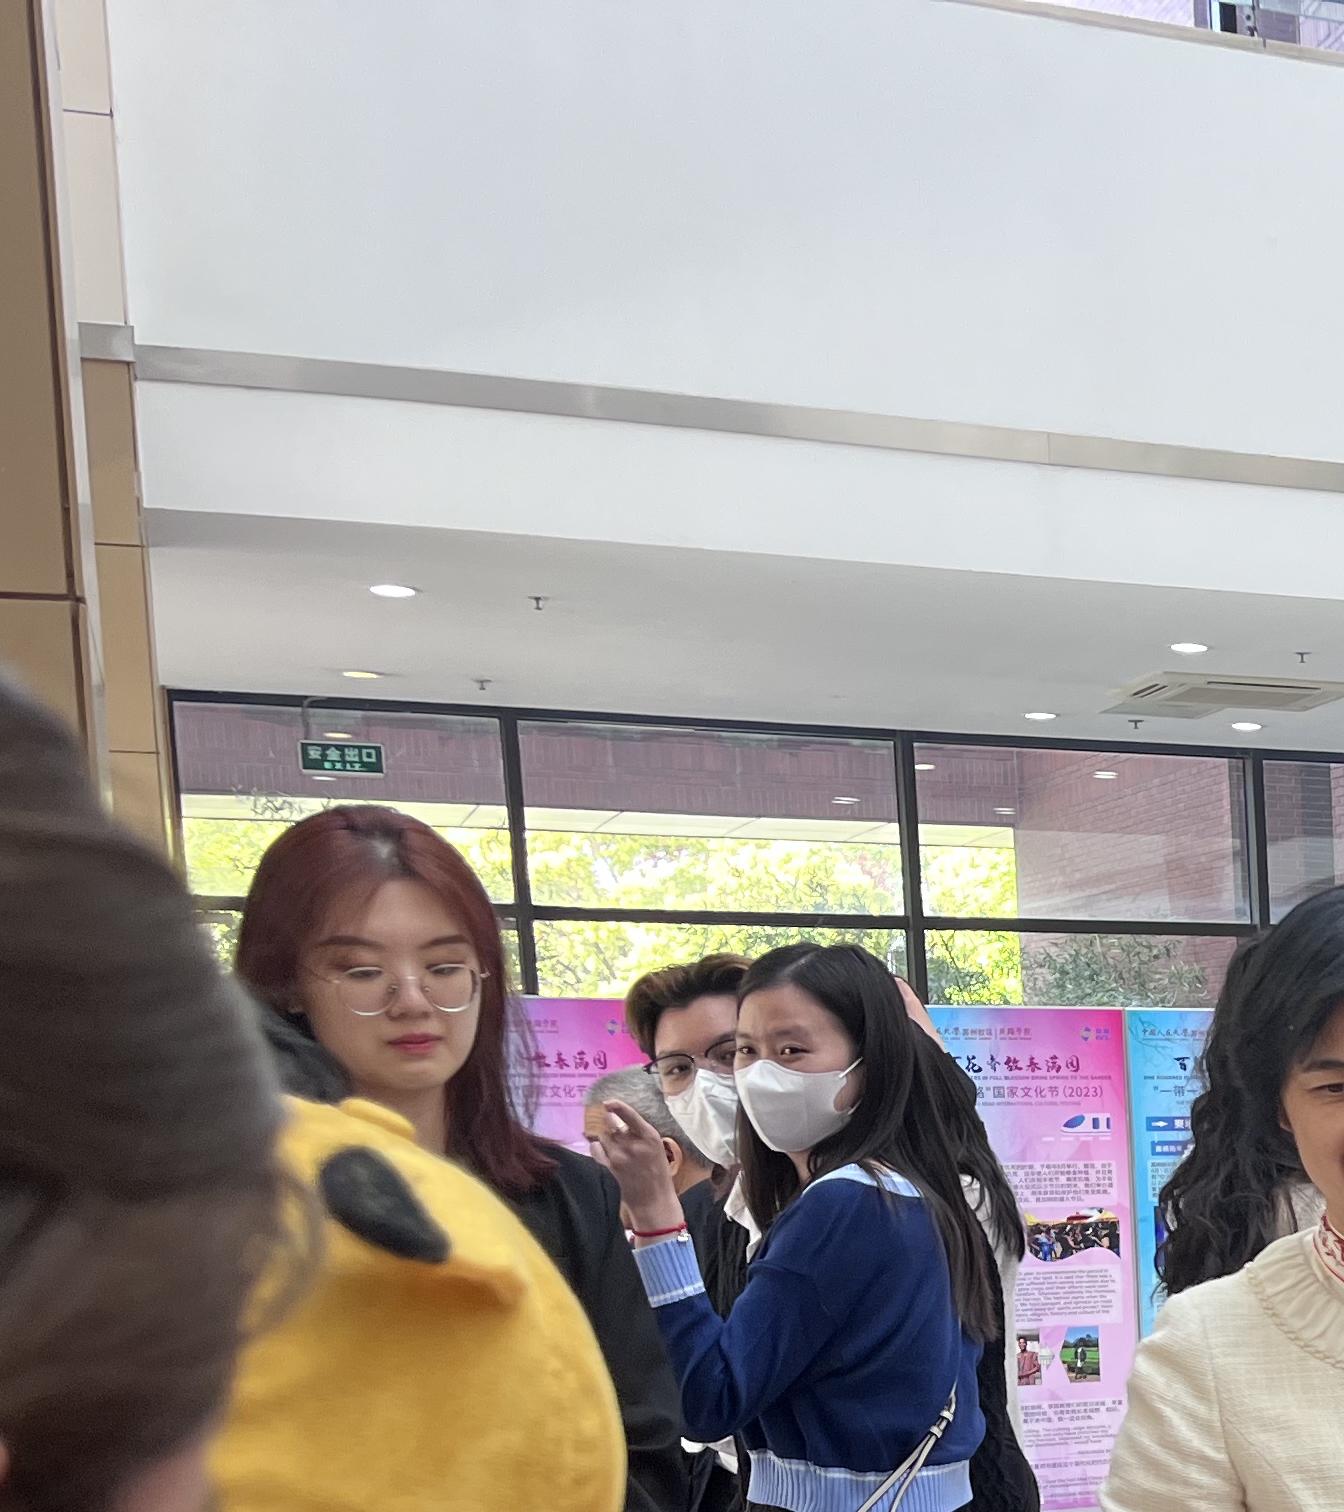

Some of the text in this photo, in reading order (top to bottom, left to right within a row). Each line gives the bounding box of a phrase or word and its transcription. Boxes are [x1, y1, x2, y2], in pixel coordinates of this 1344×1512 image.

[307, 745, 377, 762] 安全出口
[953, 1054, 1081, 1074] 花齐放春满园
